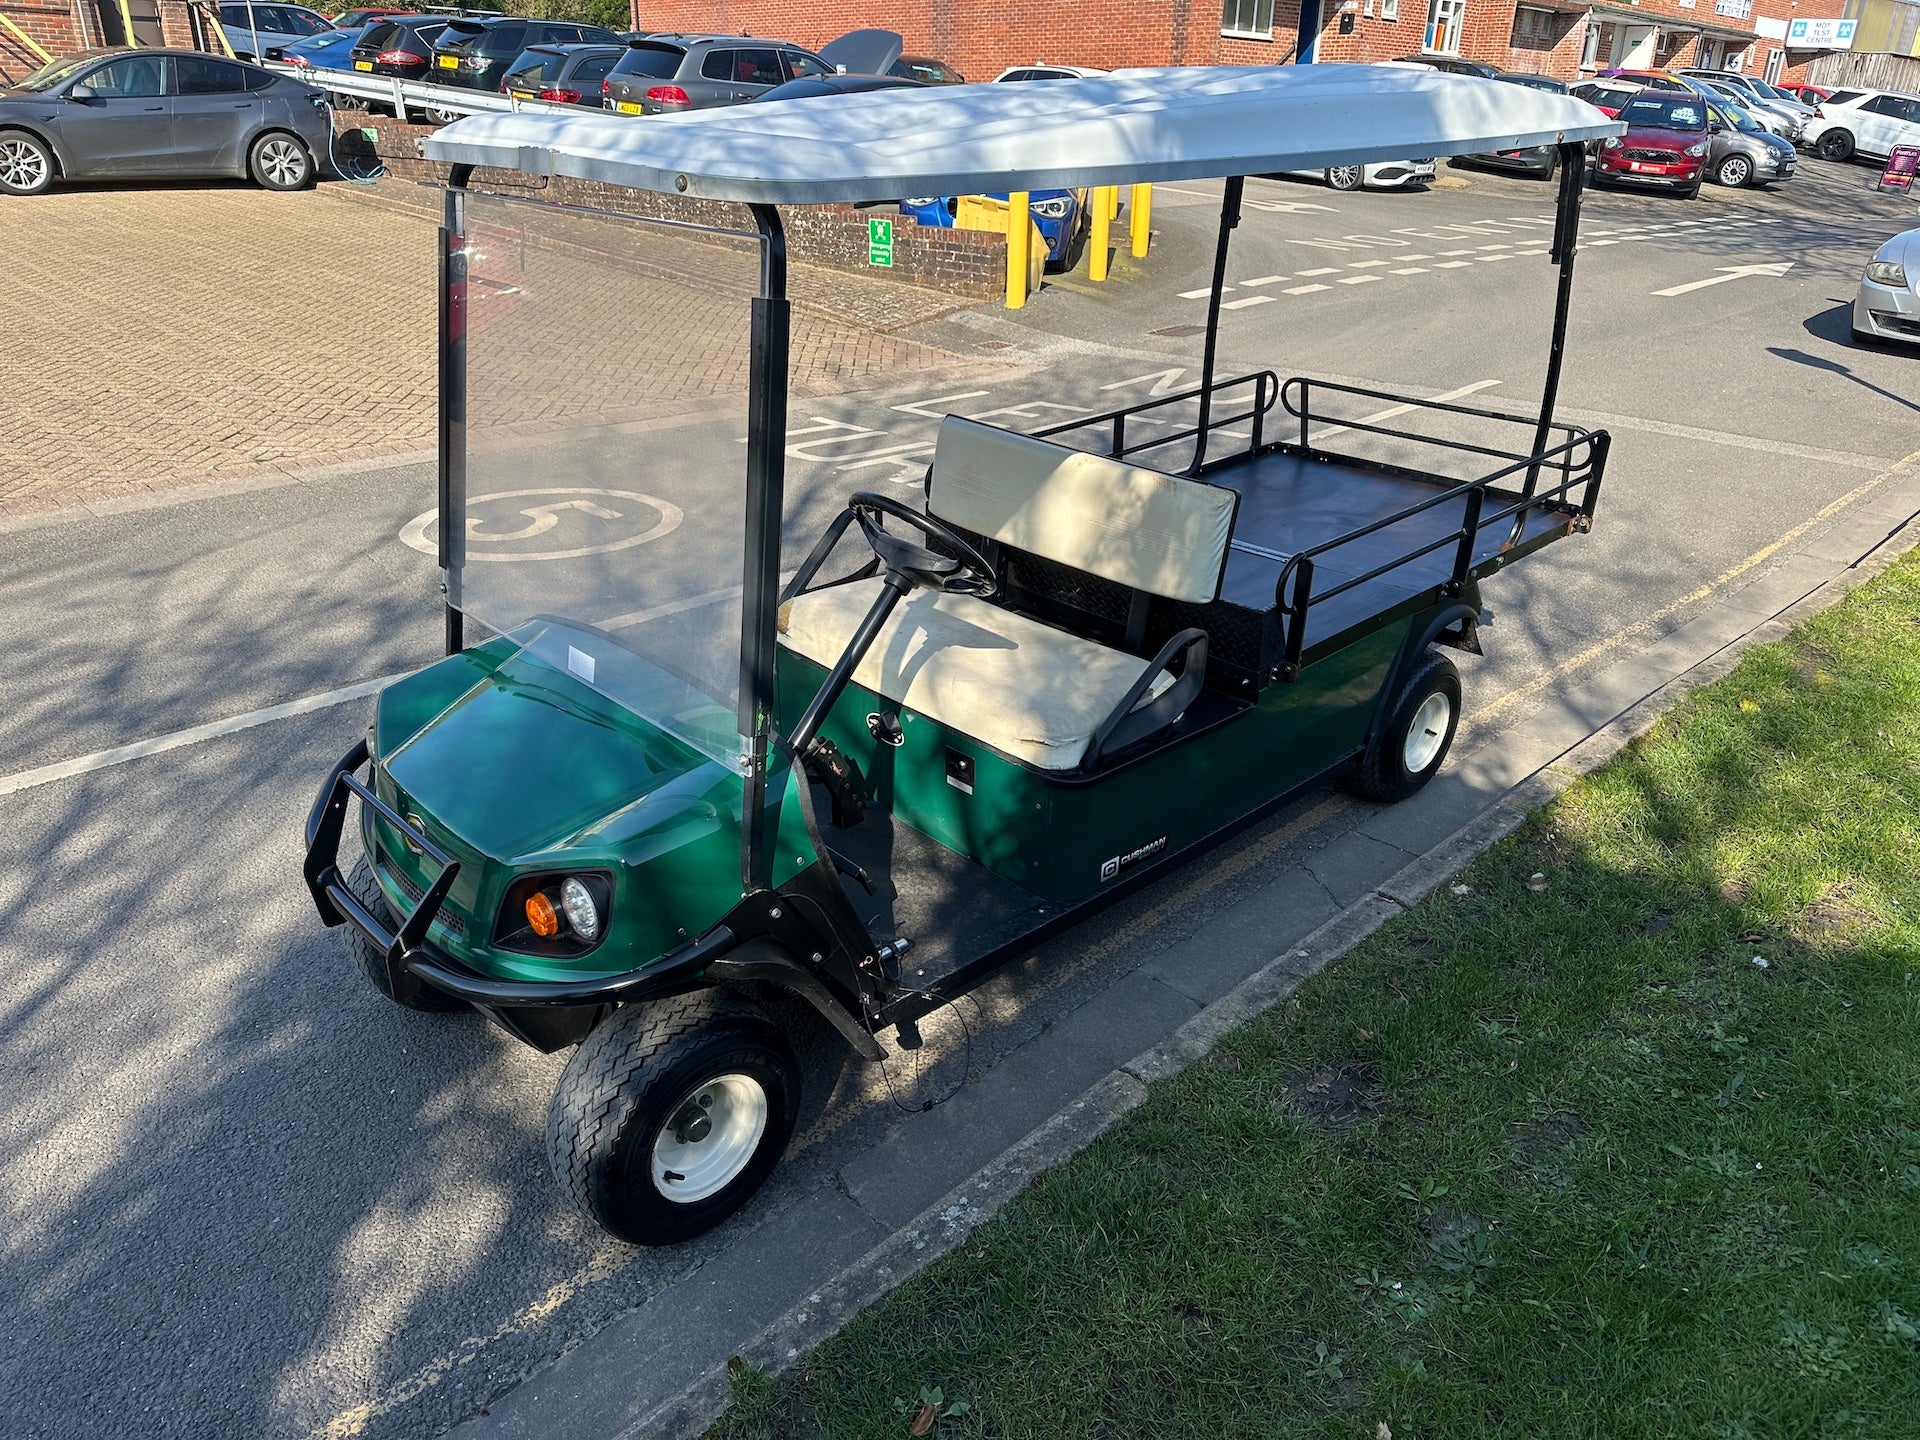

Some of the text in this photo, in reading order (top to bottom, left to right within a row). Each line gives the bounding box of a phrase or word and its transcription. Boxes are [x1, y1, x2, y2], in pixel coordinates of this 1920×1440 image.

[1284, 234, 1412, 251] NO
[465, 499, 624, 542] 5
[1120, 836, 1166, 865] CUSHMAN
